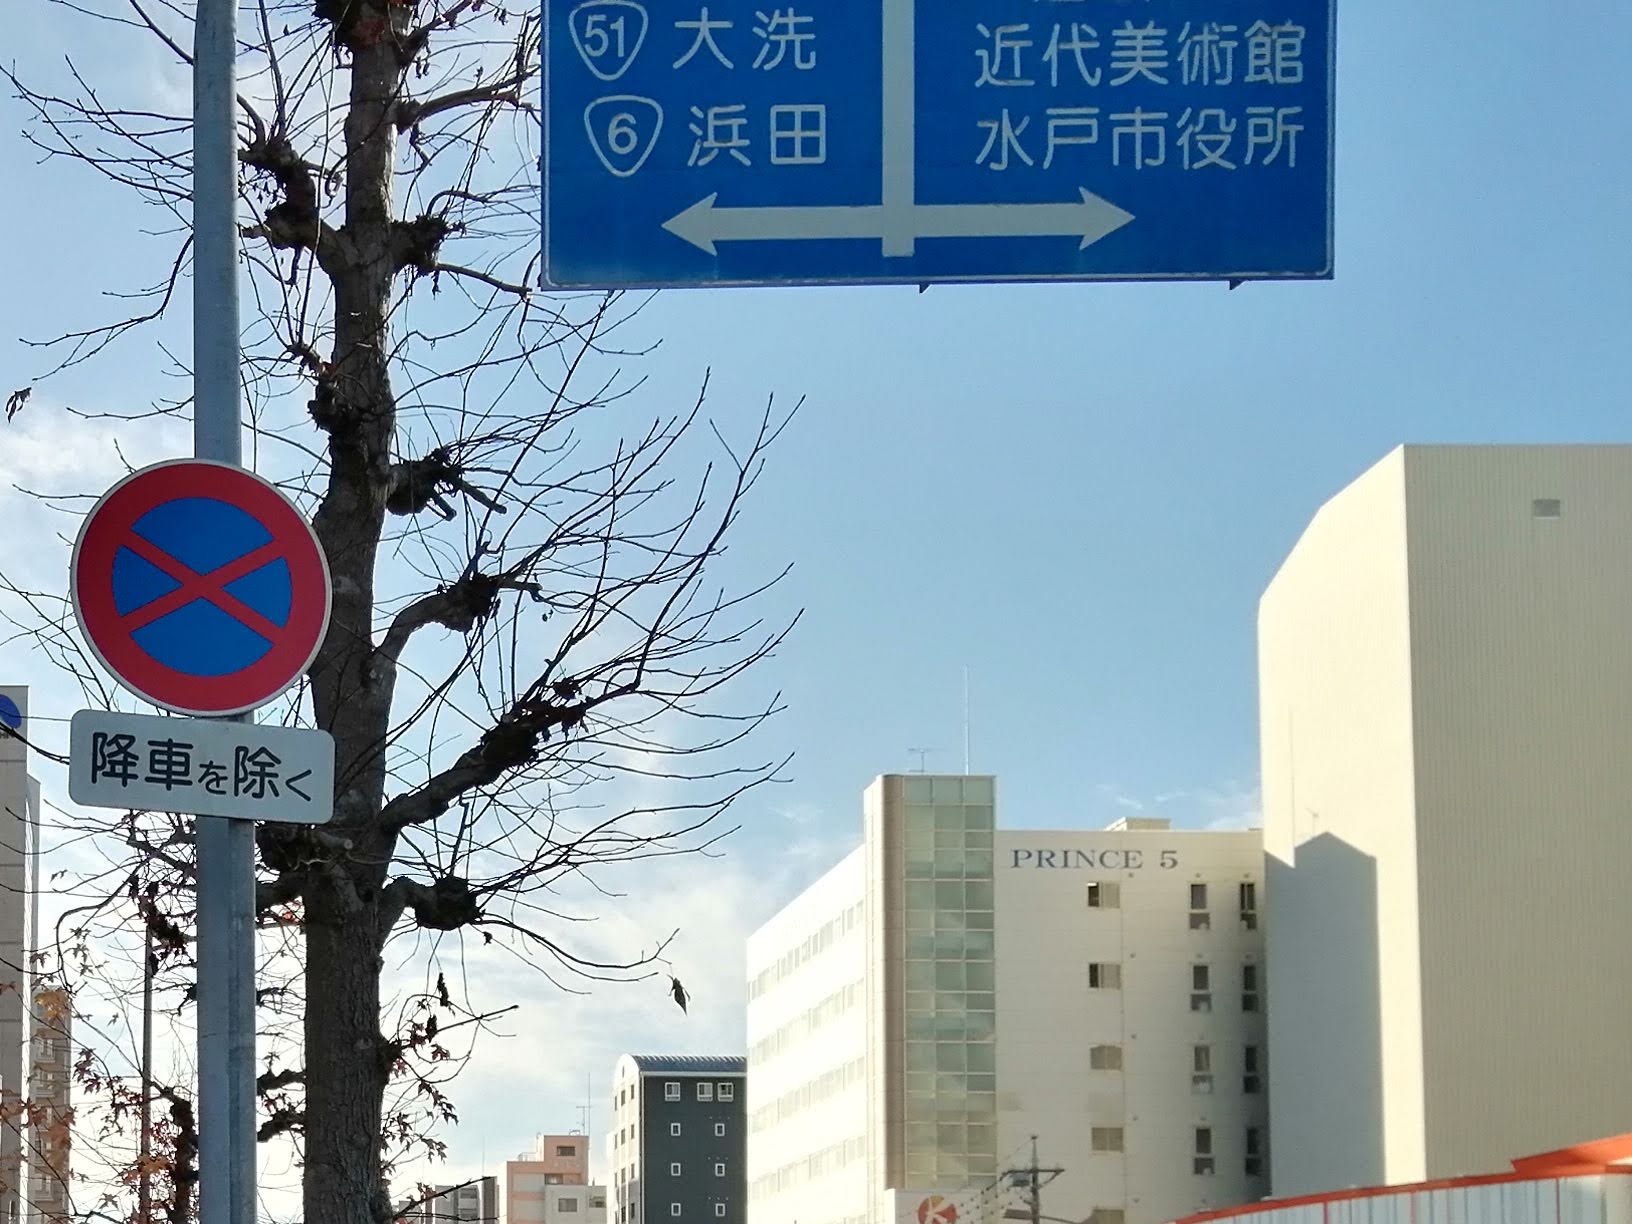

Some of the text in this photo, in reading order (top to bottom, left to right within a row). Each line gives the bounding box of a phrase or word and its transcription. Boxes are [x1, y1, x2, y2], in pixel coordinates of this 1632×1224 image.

[583, 14, 626, 58] 51
[671, 6, 817, 72] 大洗
[974, 19, 1306, 87] 近代美術館
[607, 112, 639, 155] 6
[686, 104, 827, 167] 浜田
[974, 105, 1305, 171] 水戸市役所
[91, 731, 313, 803] 降車を除く
[1009, 848, 1179, 870] PRINCE 5
